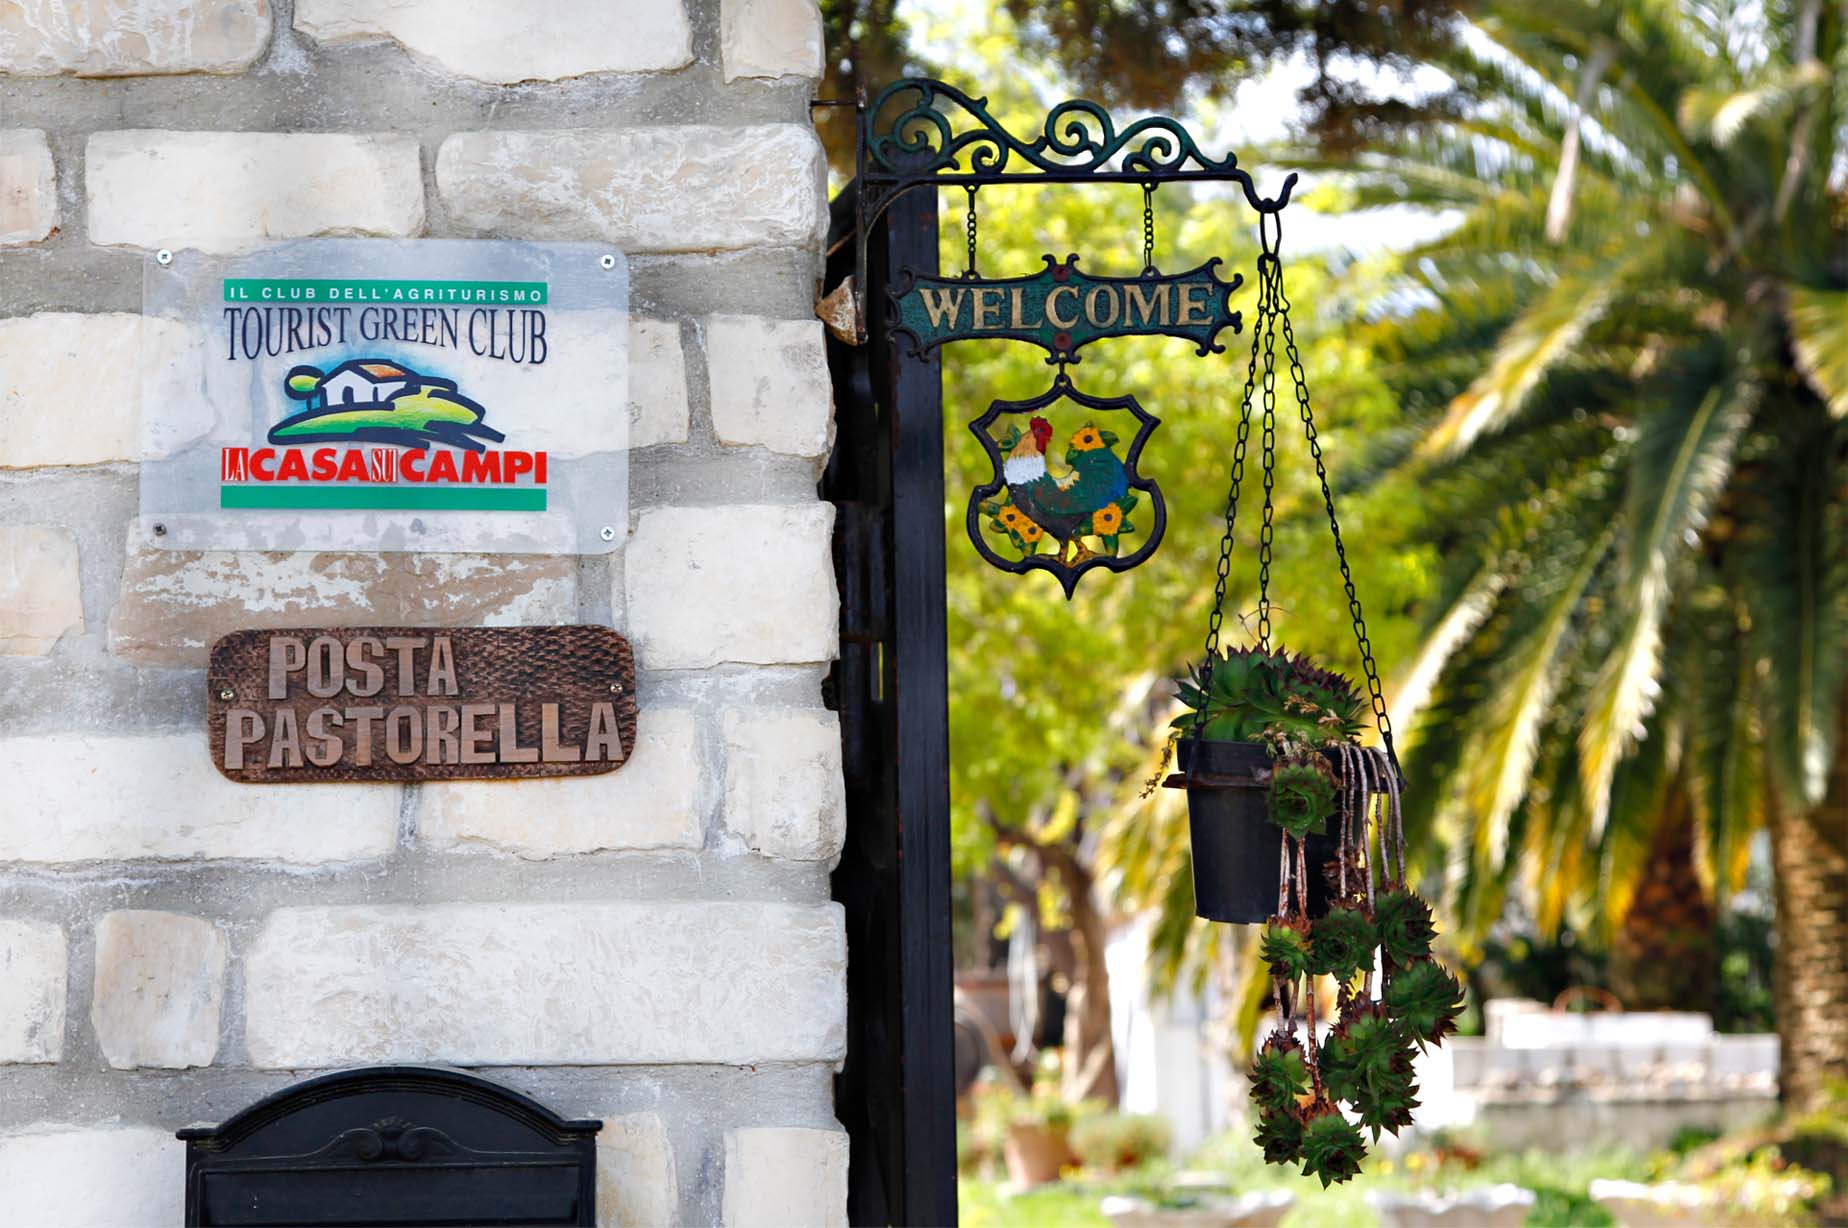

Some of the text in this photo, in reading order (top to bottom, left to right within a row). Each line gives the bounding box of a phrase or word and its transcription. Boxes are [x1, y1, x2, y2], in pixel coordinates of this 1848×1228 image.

[230, 287, 541, 302] IL CLUB DELL'AGRITURISMO
[920, 283, 1215, 330] WELCOME
[224, 306, 548, 364] TOURIST GREEN CLUB
[223, 447, 547, 484] LA CASA SUI CAMPI
[268, 636, 459, 699] POSTA
[224, 702, 625, 770] PASTORELLA
